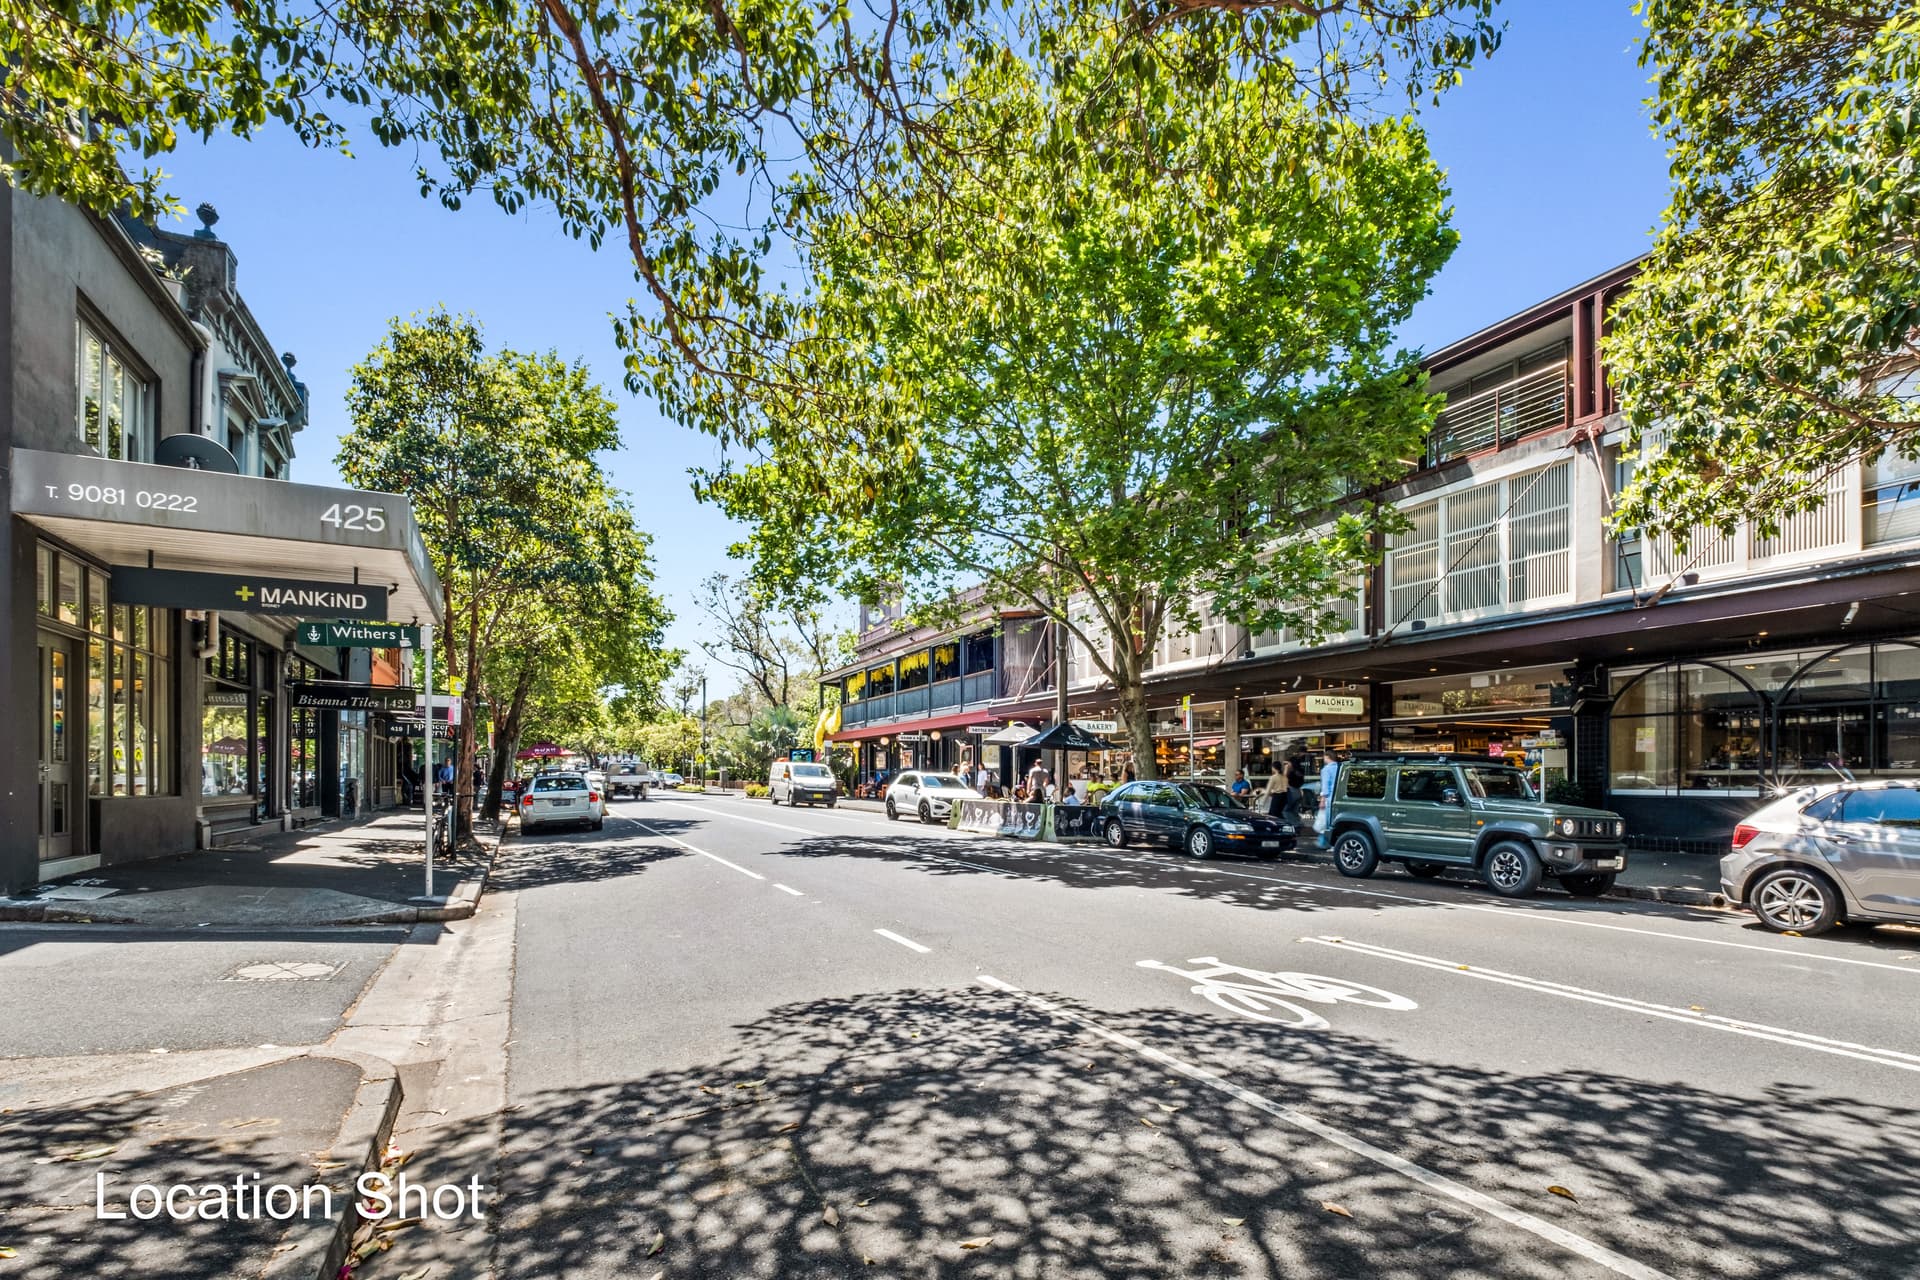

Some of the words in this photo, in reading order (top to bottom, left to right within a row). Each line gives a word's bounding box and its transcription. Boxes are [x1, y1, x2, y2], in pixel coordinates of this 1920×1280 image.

[45, 485, 59, 499] T.
[68, 483, 125, 505] 9081
[136, 491, 198, 513] 0222
[320, 503, 386, 532] 425
[260, 587, 367, 609] MANKiND
[332, 626, 396, 640] Withers
[298, 695, 348, 707] Bisanna
[351, 697, 380, 708] Tiles
[389, 699, 412, 709] 423
[1315, 698, 1354, 707] MALONEYS
[1087, 723, 1113, 731] BAKERY
